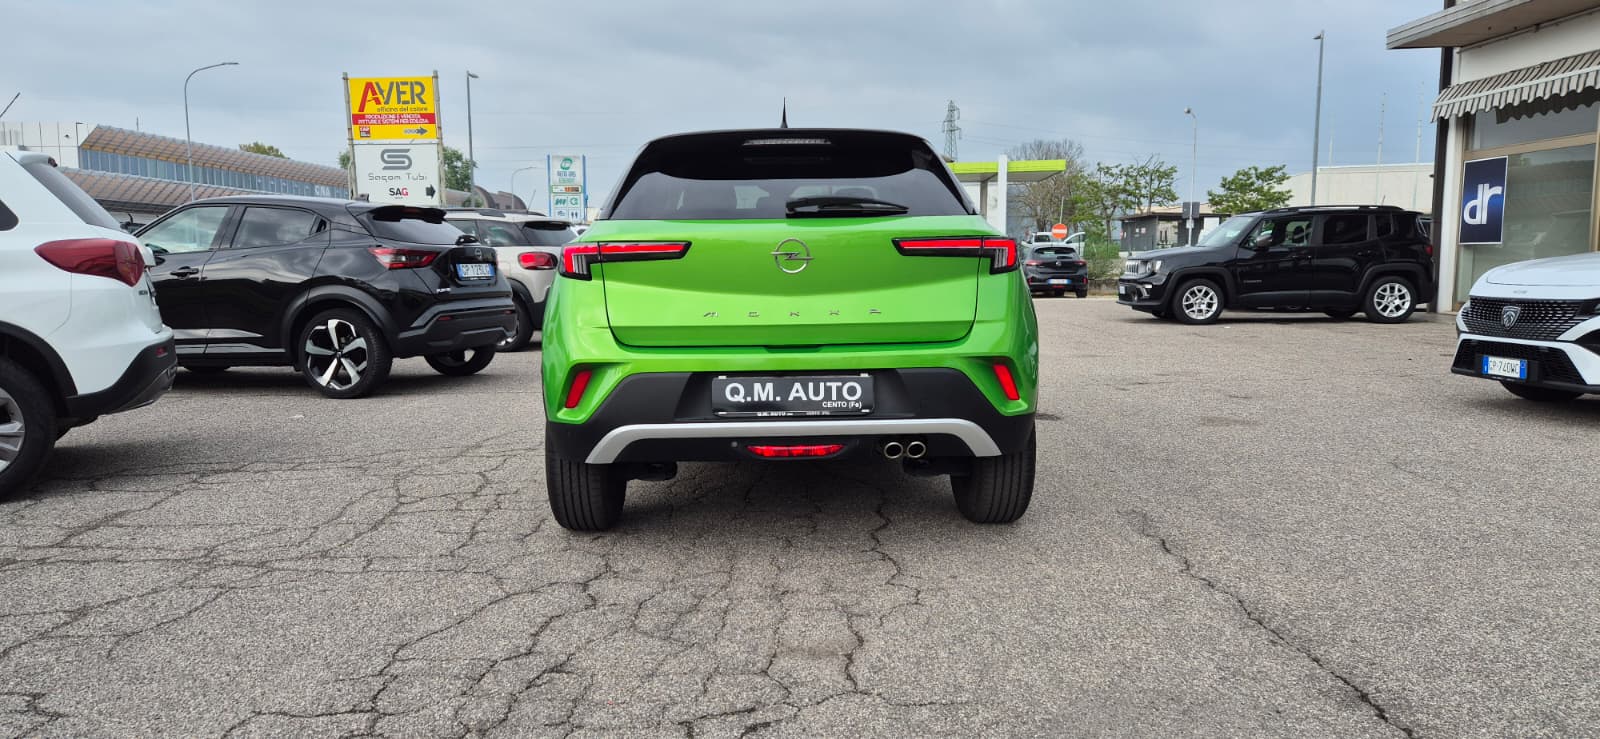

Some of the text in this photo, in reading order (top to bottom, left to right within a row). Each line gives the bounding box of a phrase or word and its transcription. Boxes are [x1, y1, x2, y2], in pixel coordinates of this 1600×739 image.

[358, 81, 427, 113] AVER
[389, 187, 409, 196] SAG
[1463, 183, 1503, 225] dr
[725, 382, 862, 403] Q.M. AUTO
[848, 401, 862, 409] (Fe)
